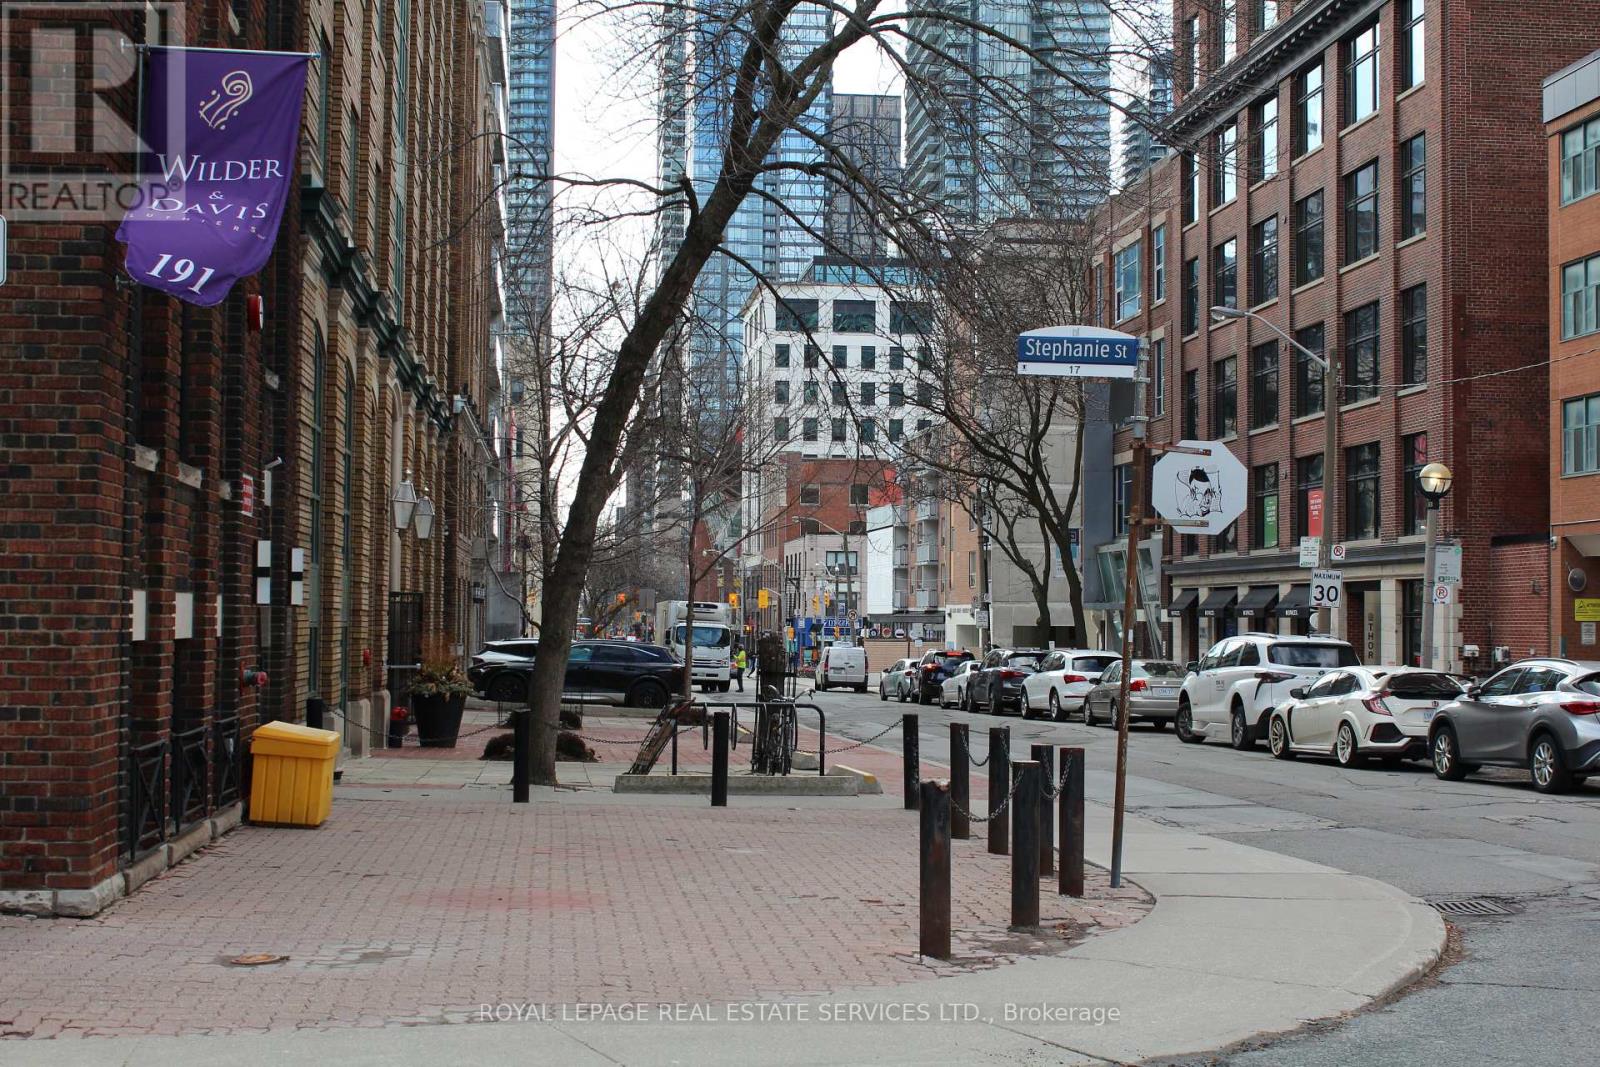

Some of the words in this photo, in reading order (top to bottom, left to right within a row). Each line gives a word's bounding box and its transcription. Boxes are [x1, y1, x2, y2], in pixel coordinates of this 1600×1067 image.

[156, 153, 283, 182] WILDER
[208, 191, 224, 200] &
[151, 197, 269, 220] DAVIS
[145, 253, 216, 295] 191
[1025, 338, 1110, 361] Stephanie
[1114, 343, 1128, 359] St
[1069, 365, 1080, 374] 17
[1313, 572, 1341, 580] MAXIMUM
[1313, 584, 1339, 603] 30
